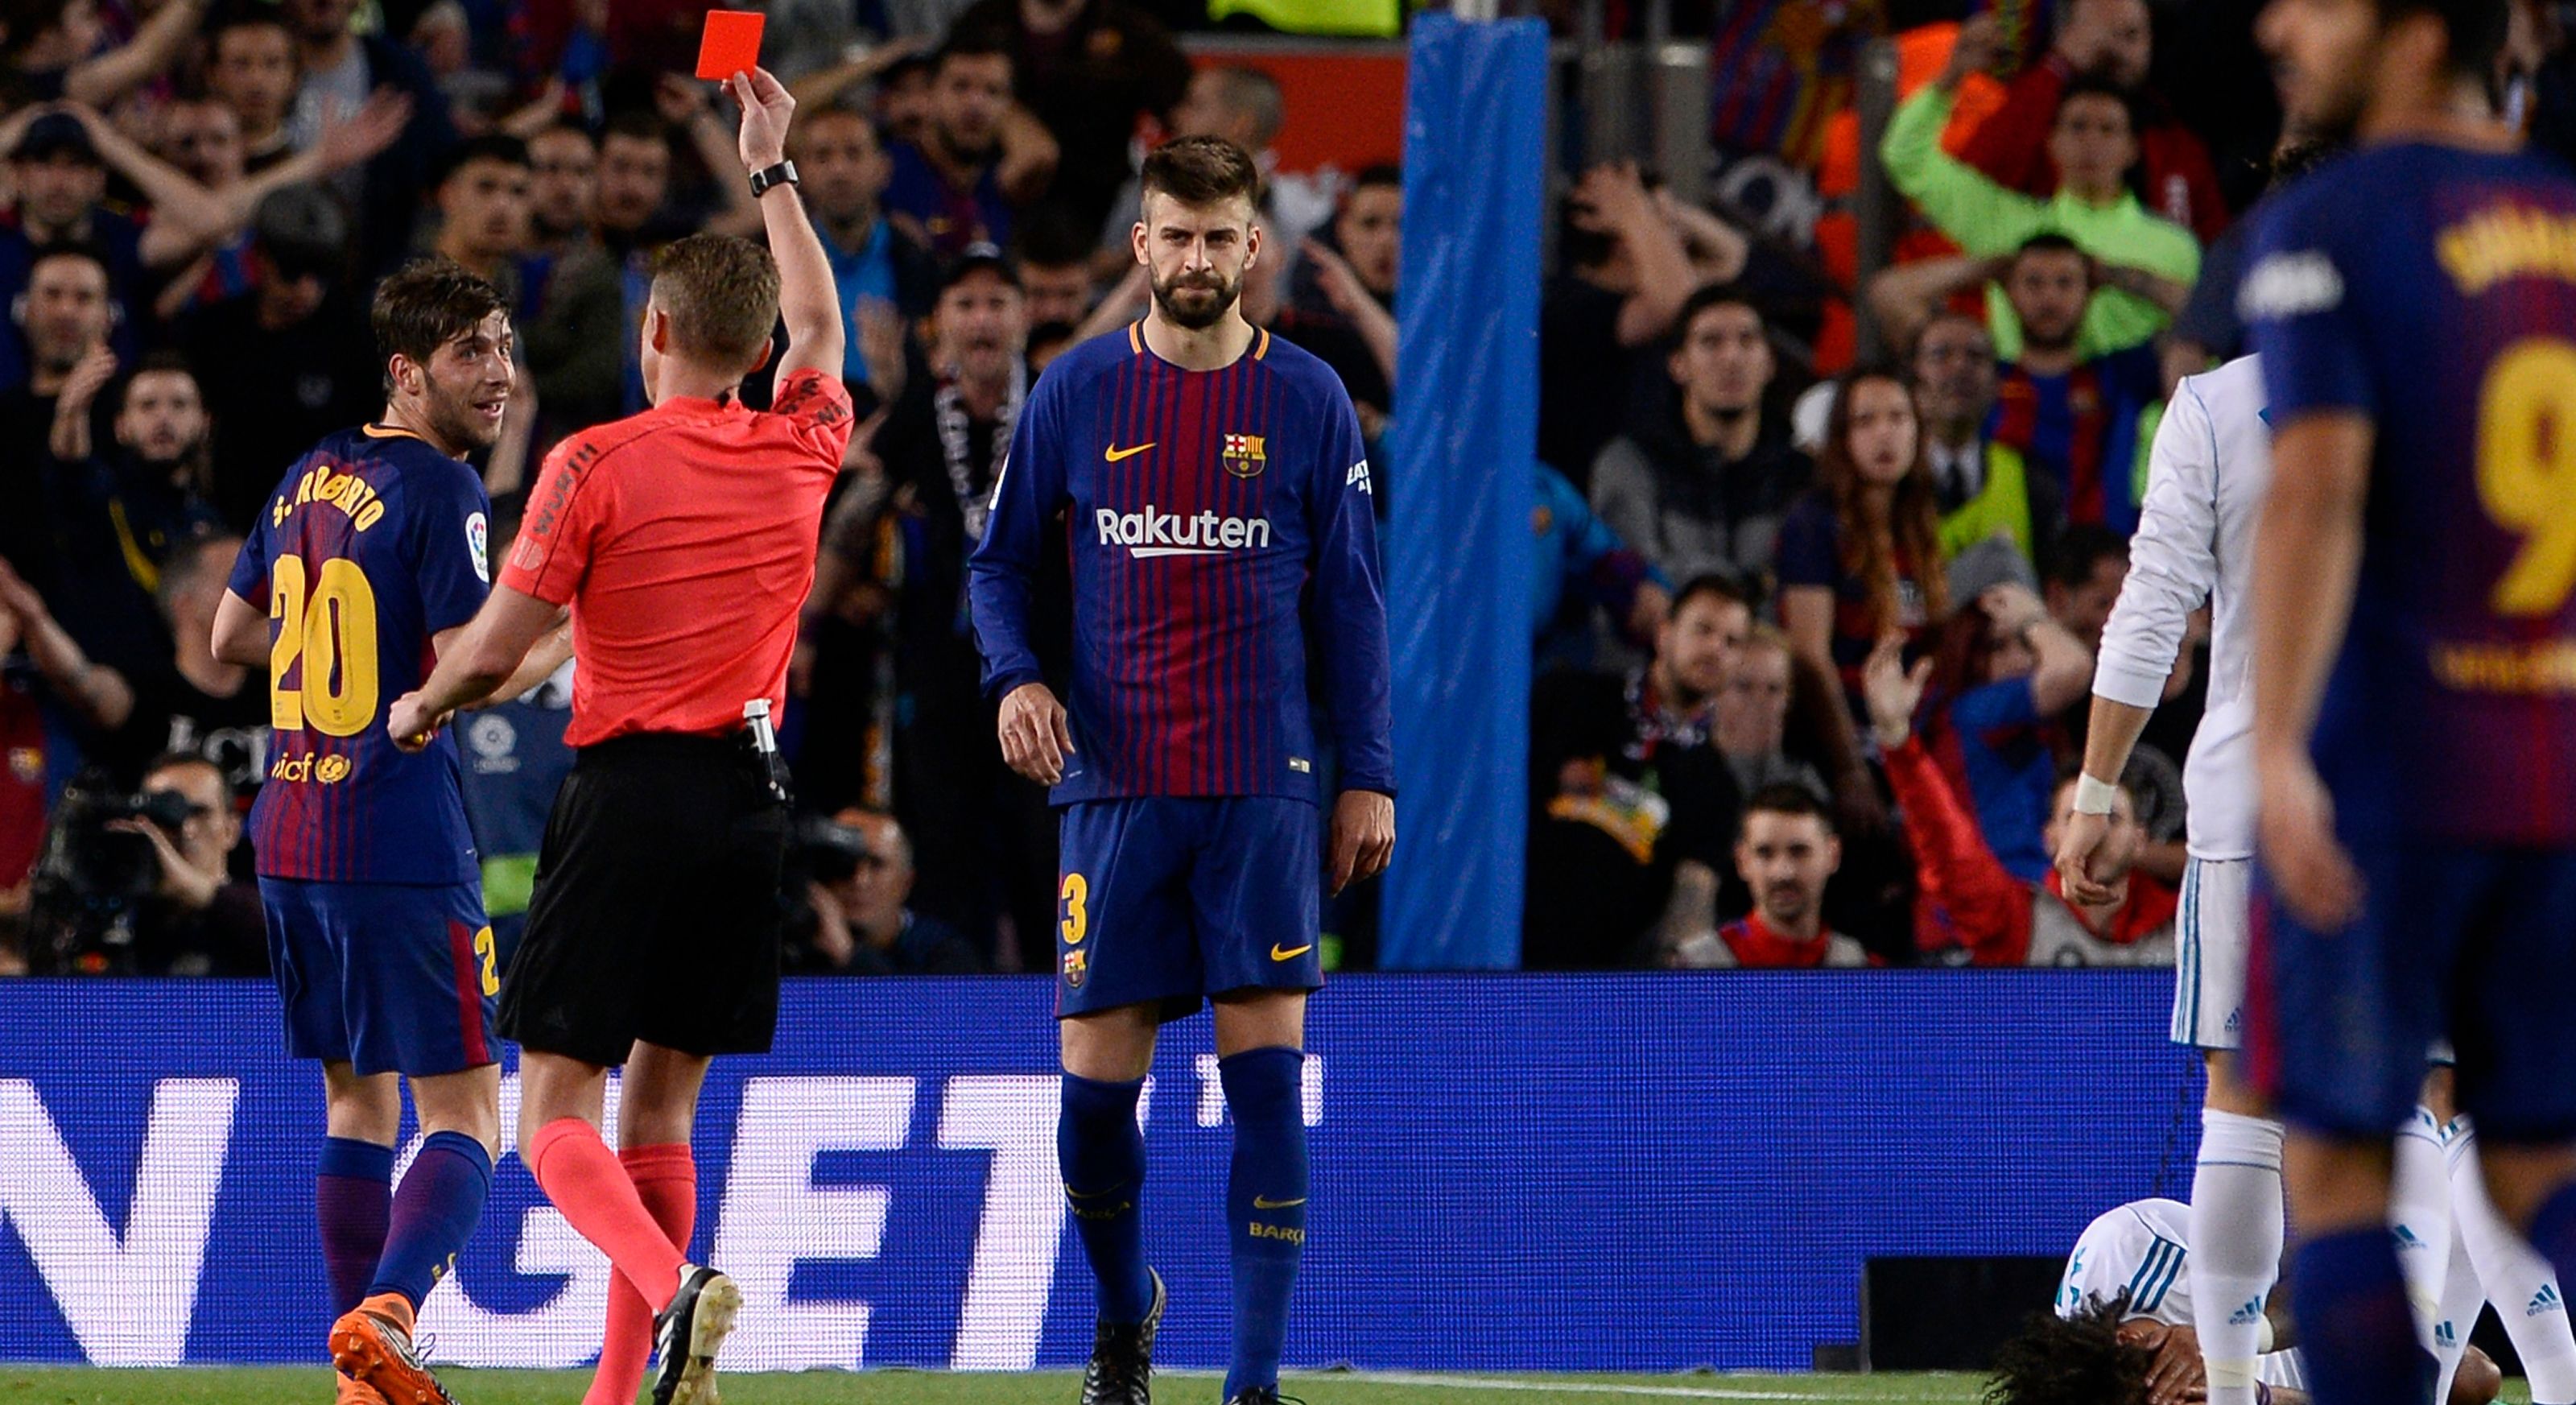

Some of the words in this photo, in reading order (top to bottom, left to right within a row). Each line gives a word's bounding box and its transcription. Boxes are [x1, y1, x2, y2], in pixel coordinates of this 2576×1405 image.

[2474, 335, 2576, 615] 9
[1096, 504, 1270, 548] Rakuten
[270, 553, 379, 736] 20
[1062, 873, 1087, 944] 3
[474, 925, 499, 996] 2
